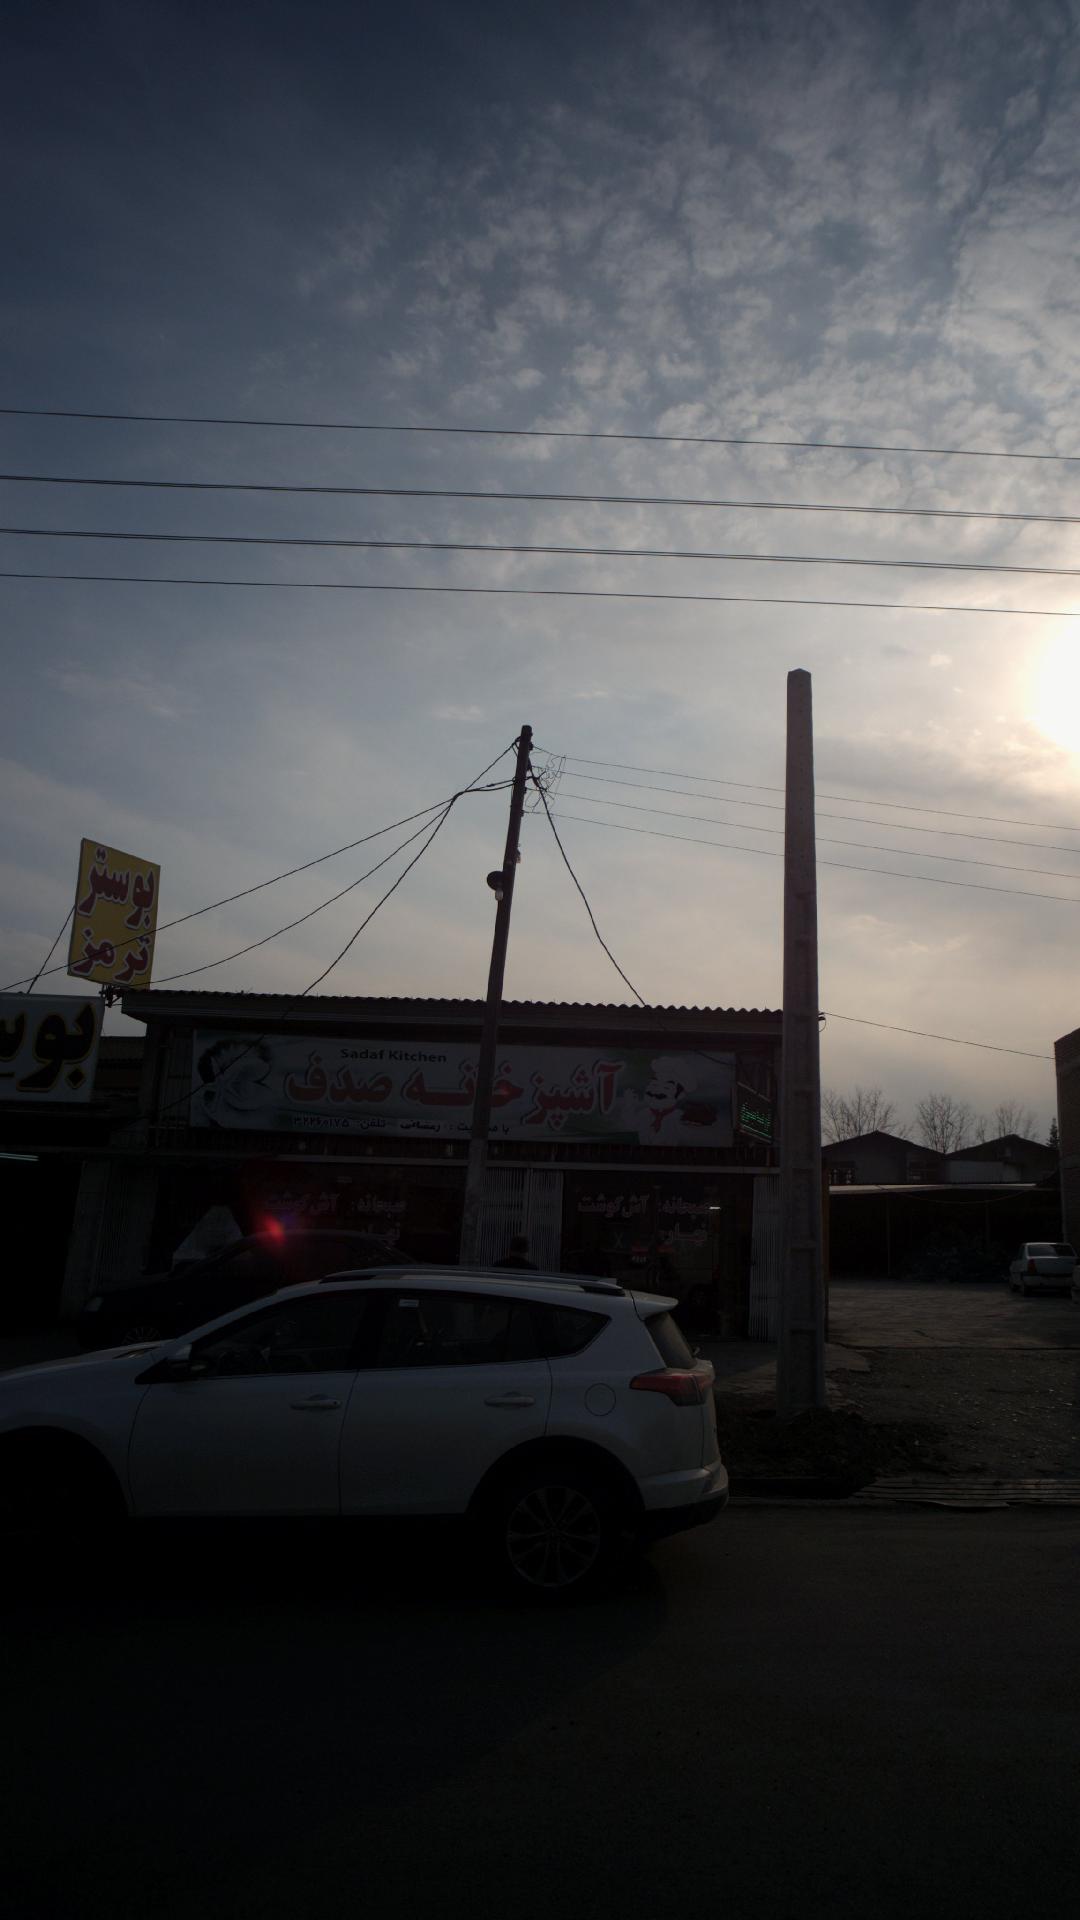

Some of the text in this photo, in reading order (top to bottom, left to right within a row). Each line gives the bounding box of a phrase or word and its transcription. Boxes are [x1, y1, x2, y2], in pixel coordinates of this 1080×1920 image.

[77, 846, 155, 928] بوستر
[71, 927, 151, 983] ترمز
[286, 1053, 392, 1103] صدف
[340, 1048, 448, 1063] Sadaf Kitchen
[359, 1118, 386, 1130] تلفن
